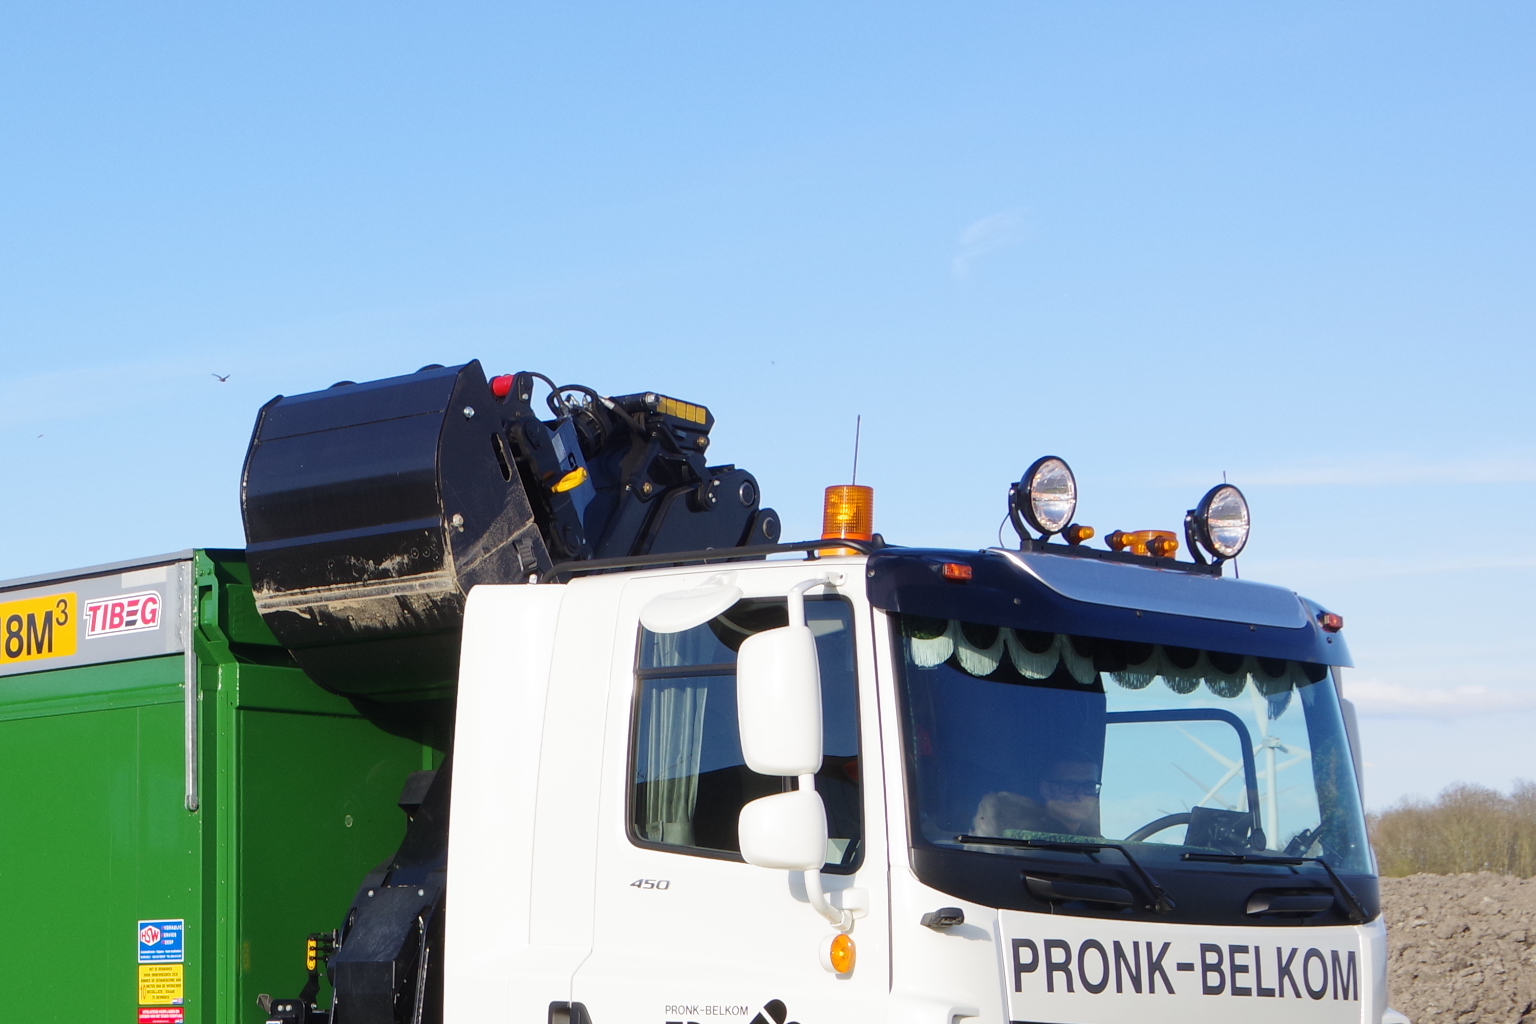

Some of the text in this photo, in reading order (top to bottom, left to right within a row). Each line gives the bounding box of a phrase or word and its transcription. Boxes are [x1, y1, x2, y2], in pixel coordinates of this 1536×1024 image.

[88, 596, 158, 632] TIBEG
[629, 878, 671, 890] 450
[141, 927, 159, 944] HSW
[1010, 938, 1359, 1001] PRONK-BELKOM
[665, 1005, 748, 1016] PRONK-BELKOM
